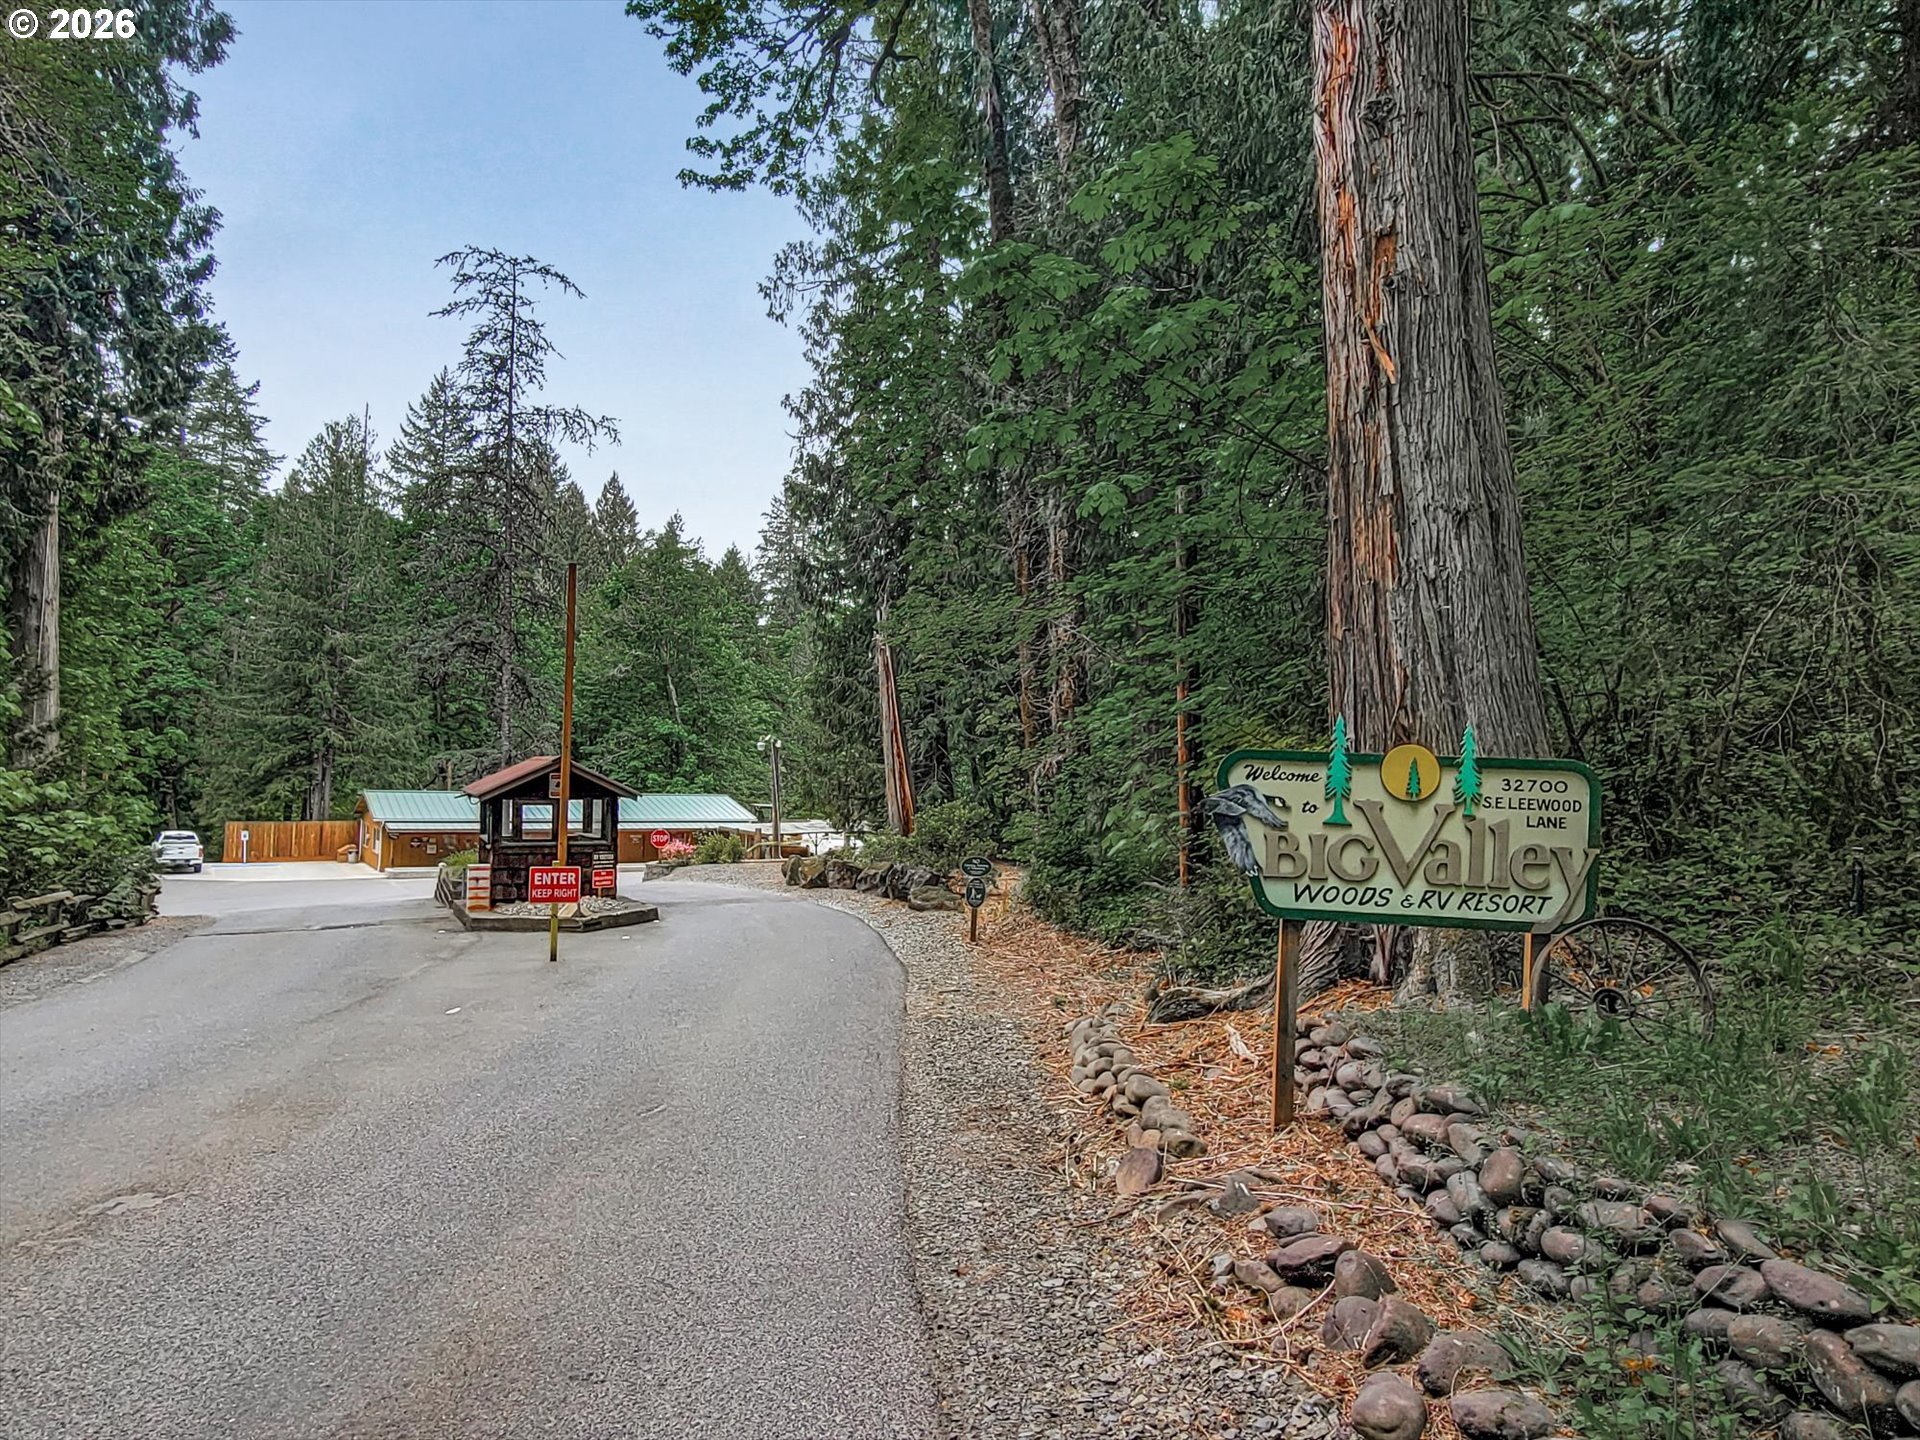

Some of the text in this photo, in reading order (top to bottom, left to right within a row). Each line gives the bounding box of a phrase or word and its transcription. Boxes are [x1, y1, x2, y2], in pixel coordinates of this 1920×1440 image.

[1244, 764, 1322, 783] Welcome
[1501, 778, 1568, 793] 32700
[1302, 801, 1319, 814] to
[1508, 797, 1582, 813] LEEWOOD
[1526, 815, 1567, 829] LANE
[652, 834, 668, 843] STOP
[1263, 799, 1600, 934] BIG Valley
[534, 872, 576, 885] ENTER
[532, 888, 577, 898] KEEP RIGHT
[1294, 883, 1553, 915] WOODS & RV RESORT
